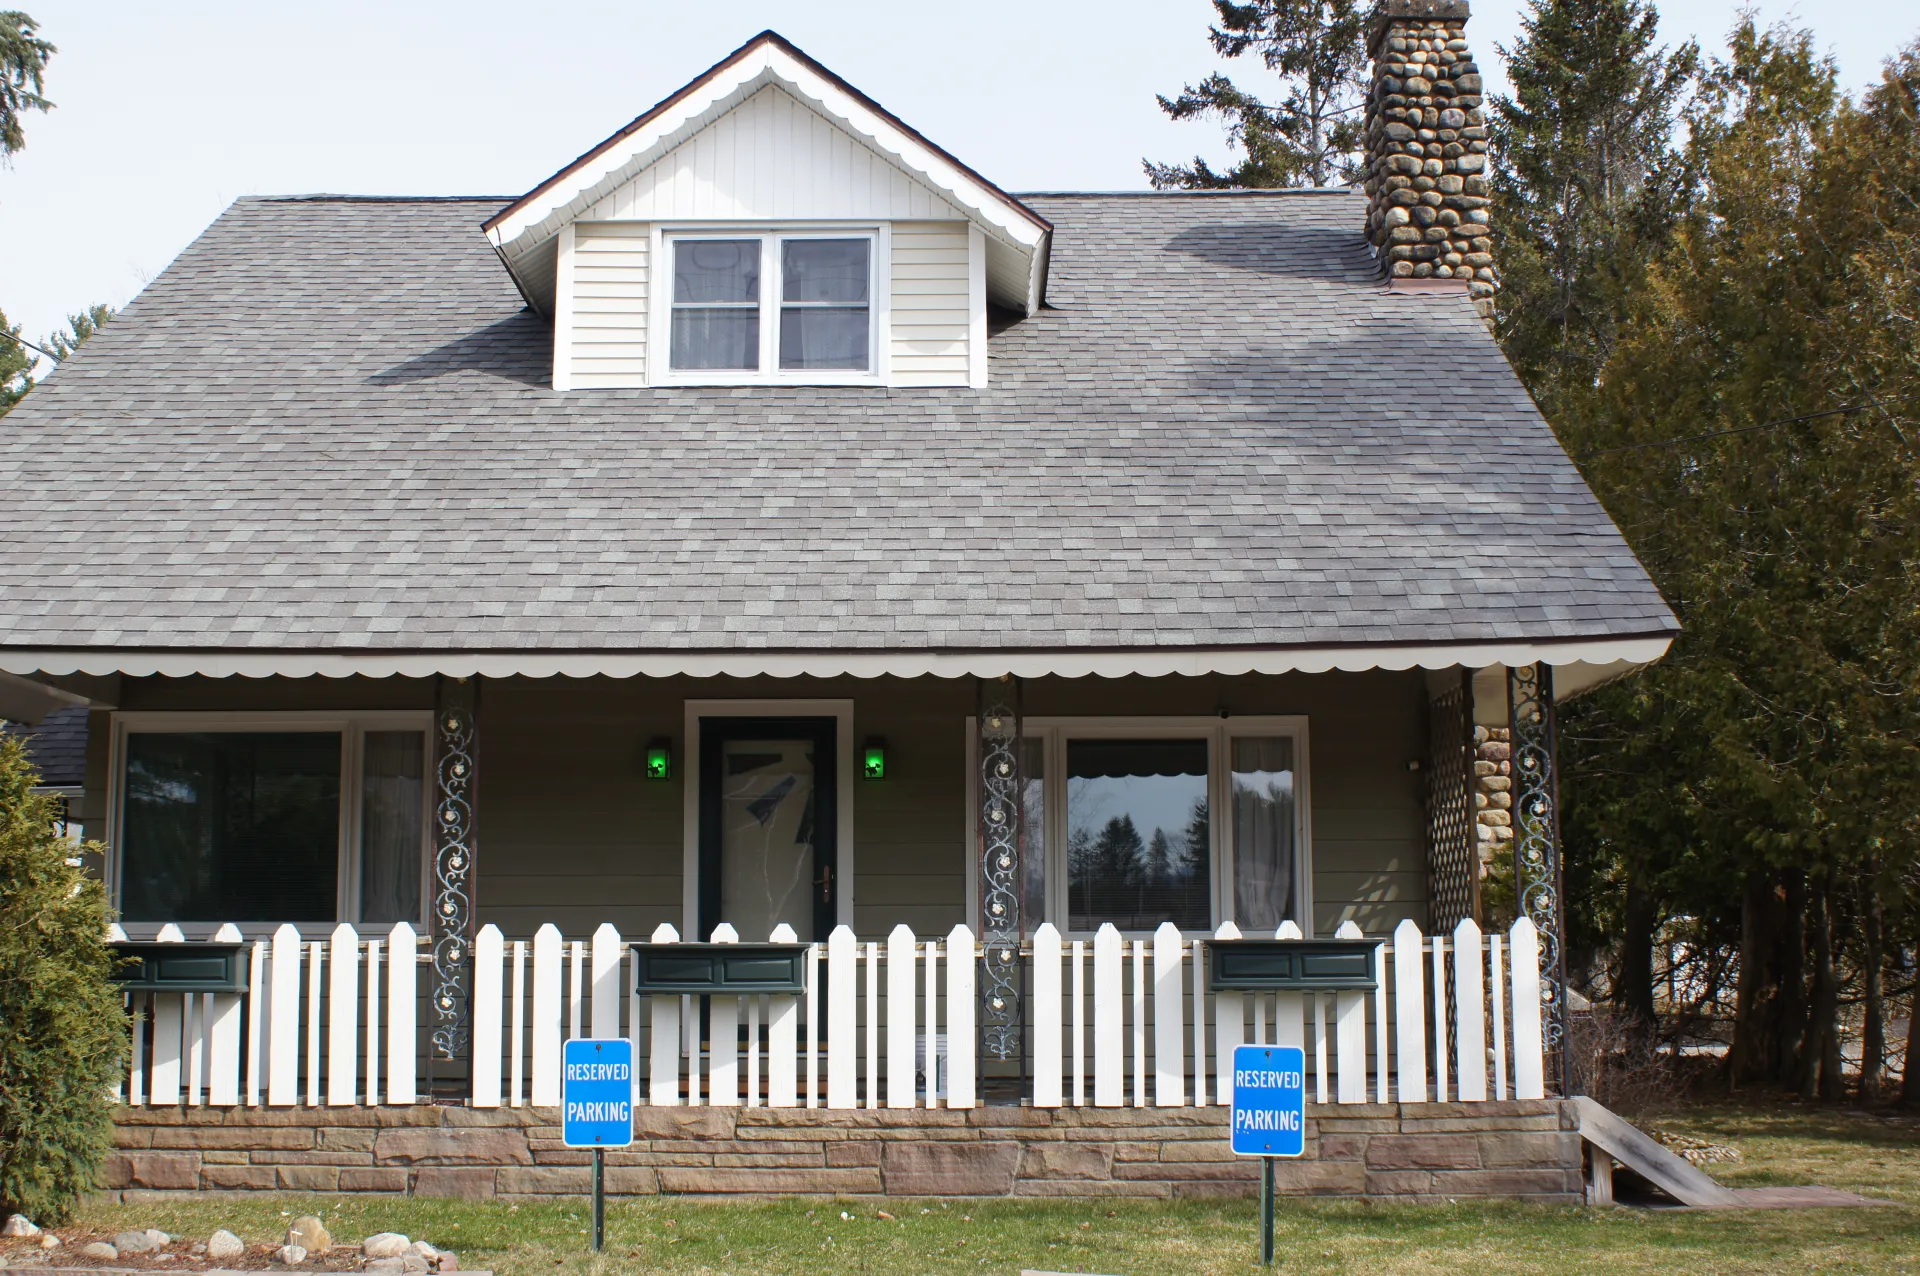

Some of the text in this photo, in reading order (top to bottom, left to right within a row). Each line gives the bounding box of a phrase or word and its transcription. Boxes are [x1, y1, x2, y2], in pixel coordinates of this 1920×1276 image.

[567, 1063, 629, 1081] RESERVED
[1236, 1070, 1300, 1089] RESERVED
[567, 1101, 628, 1122] PARKING
[1236, 1109, 1299, 1131] PARKING
